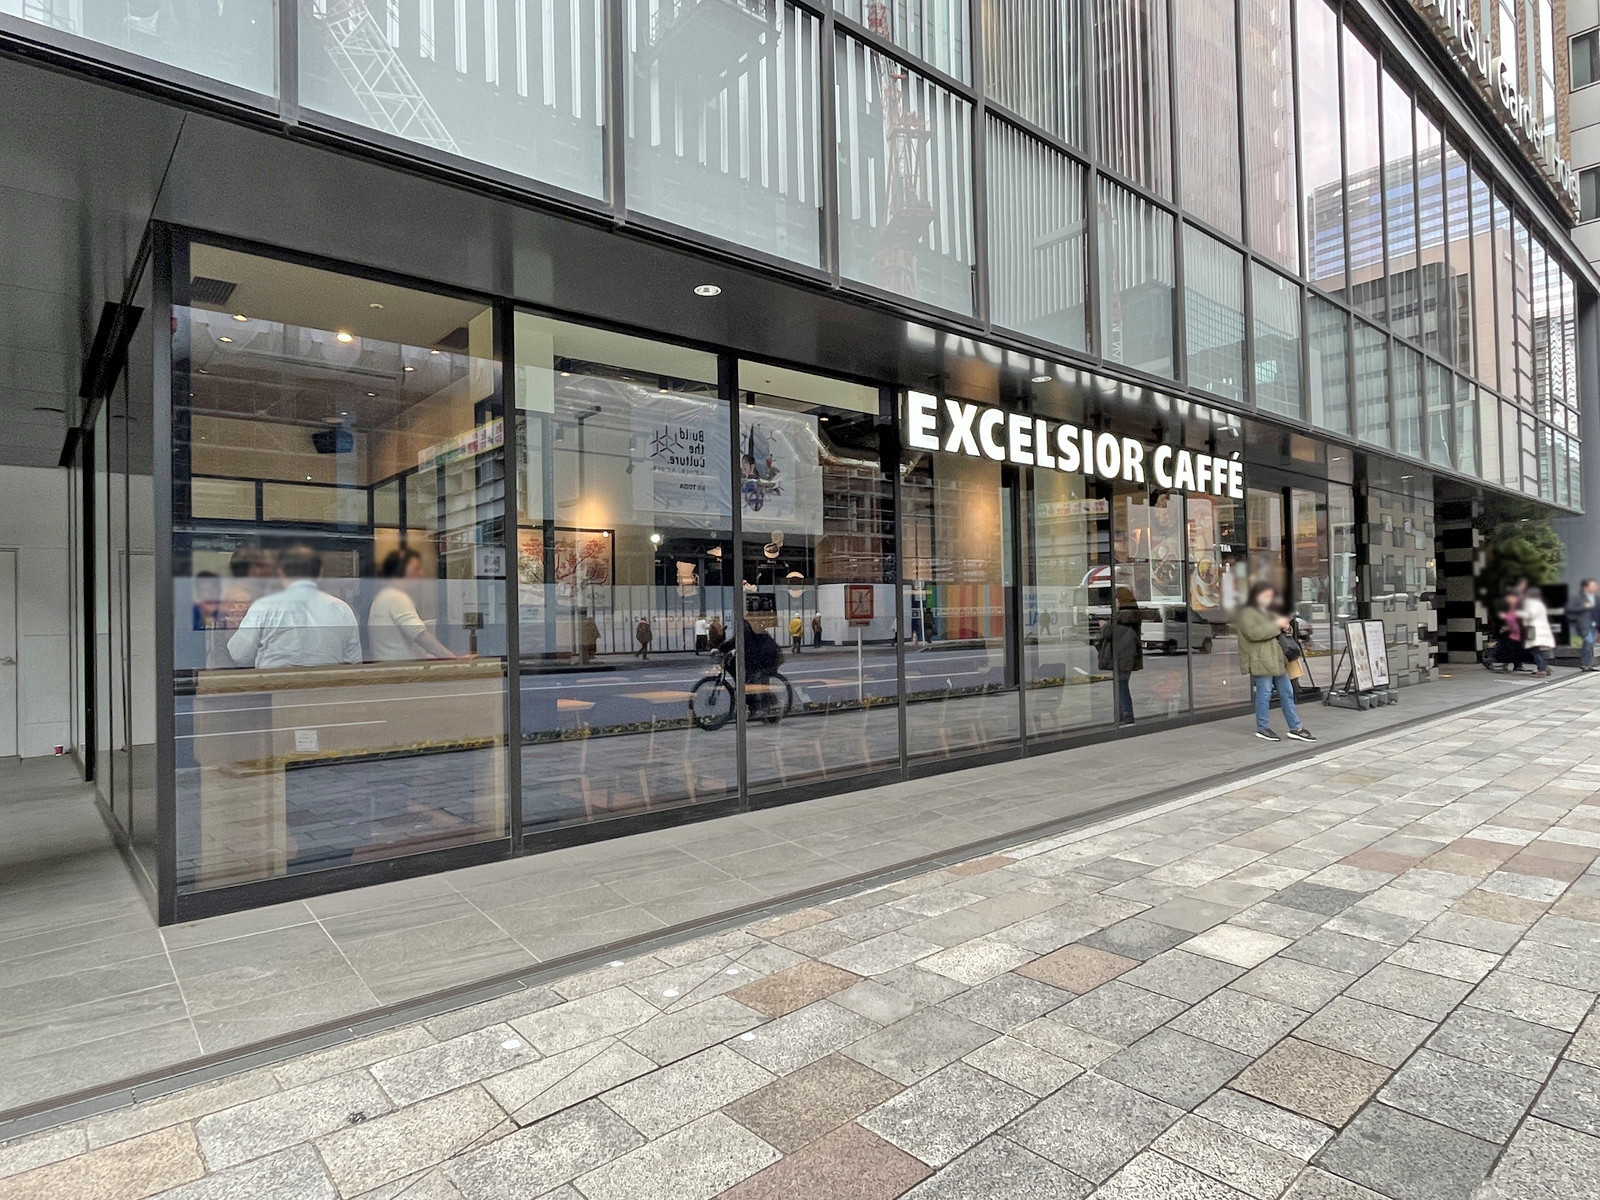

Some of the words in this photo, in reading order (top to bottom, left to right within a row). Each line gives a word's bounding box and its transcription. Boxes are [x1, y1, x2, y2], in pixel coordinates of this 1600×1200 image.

[1496, 56, 1548, 165] Garden
[907, 389, 1145, 484] EXCELSIOR
[1153, 444, 1244, 500] CAFFÉ
